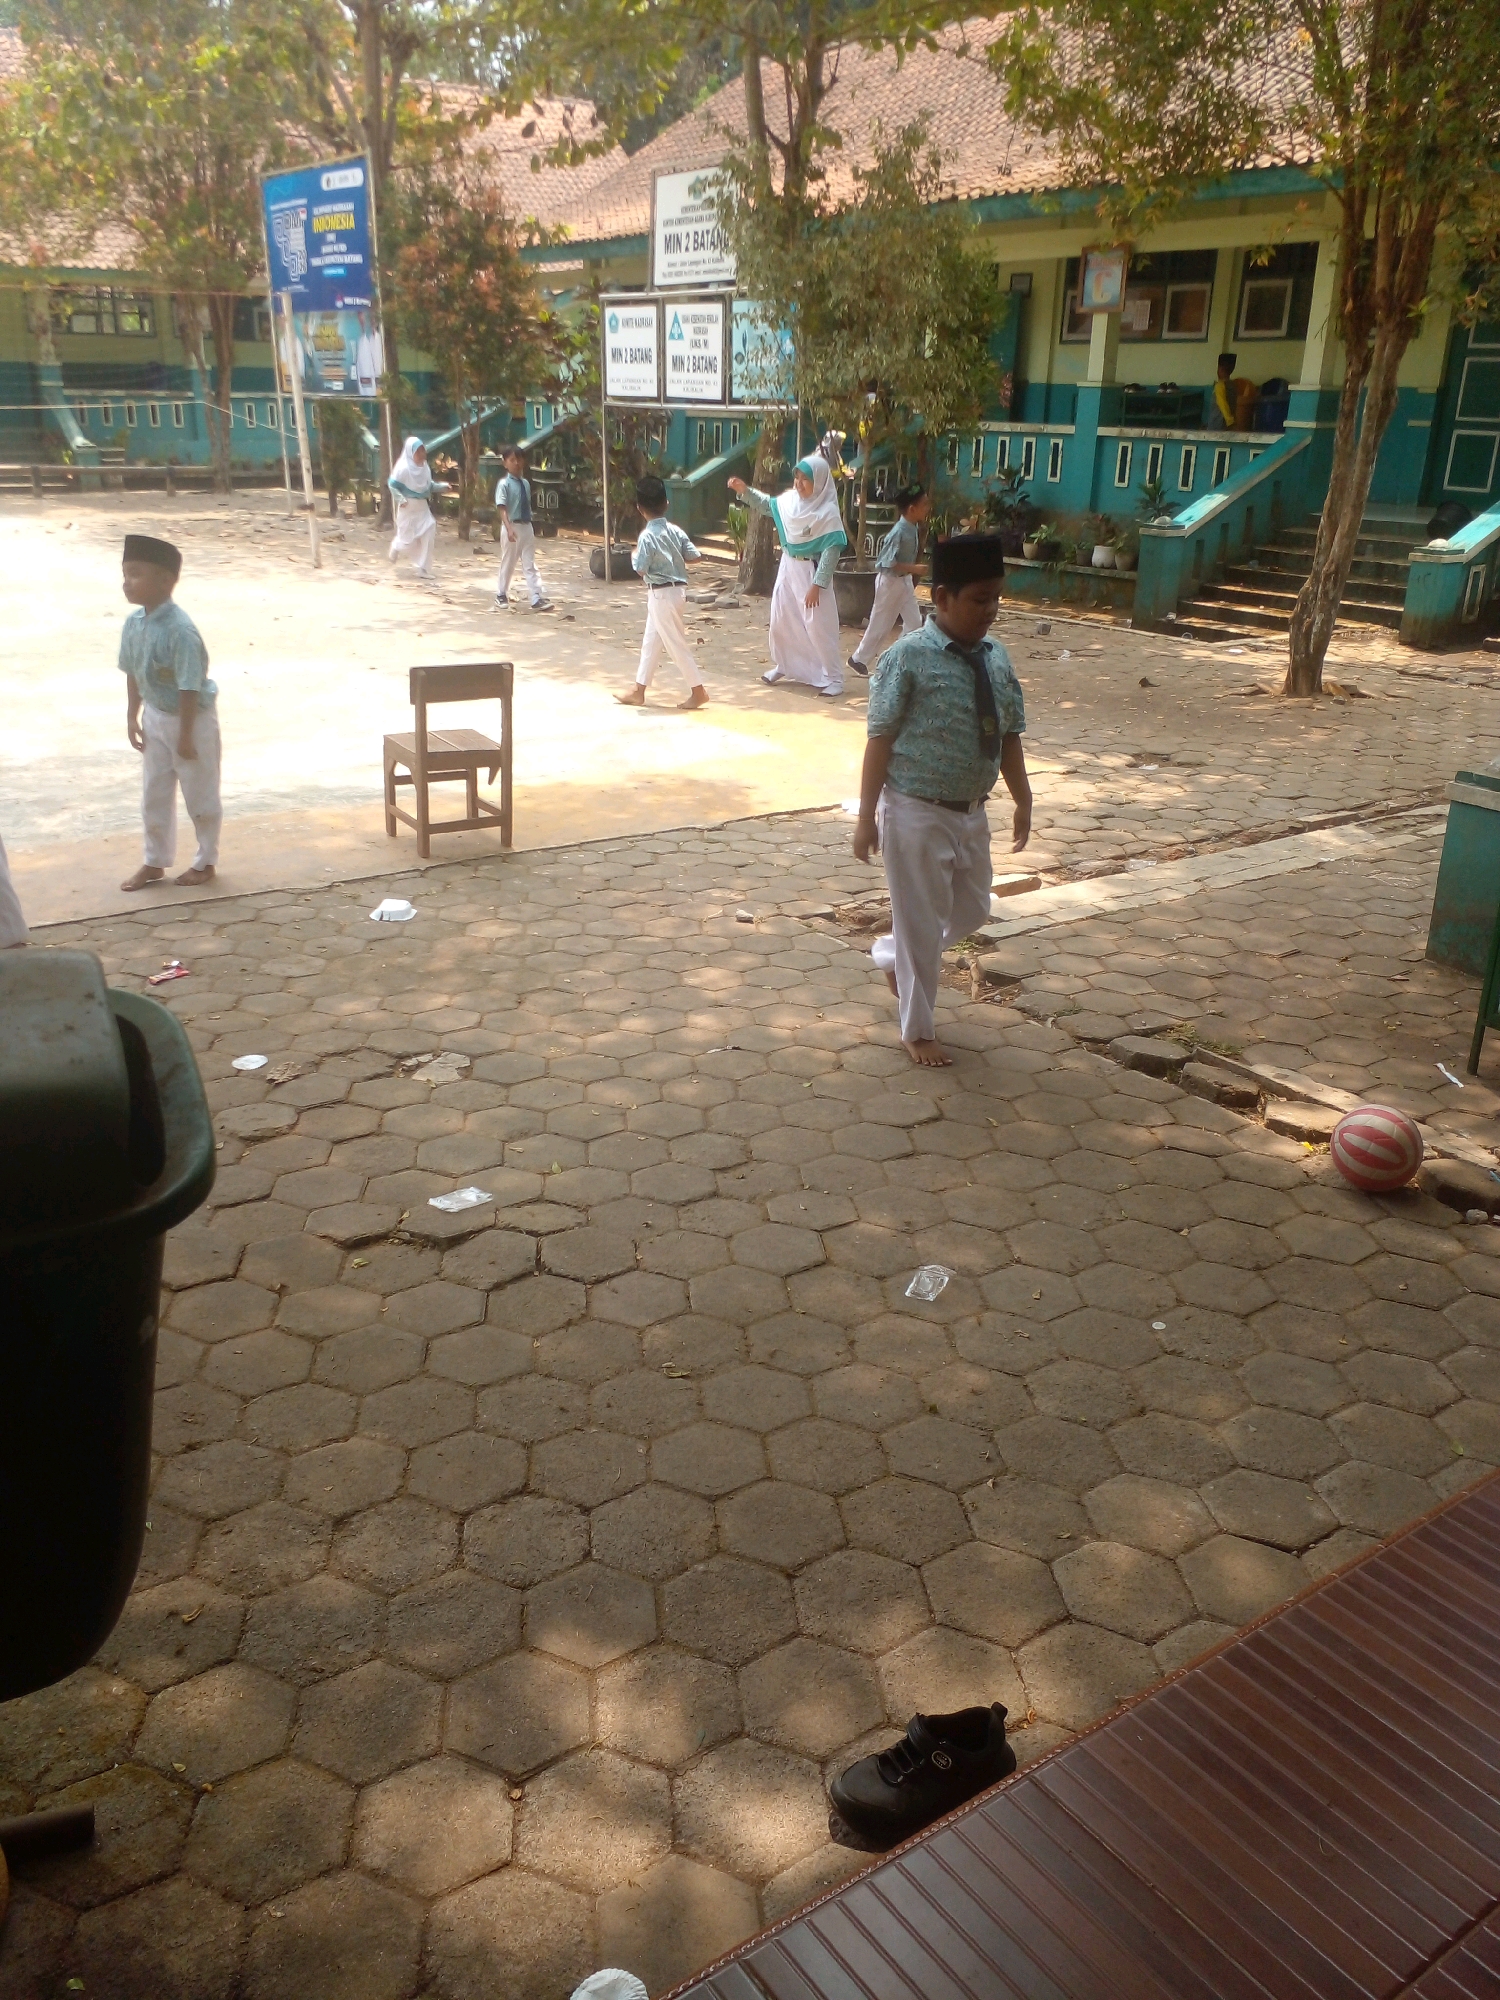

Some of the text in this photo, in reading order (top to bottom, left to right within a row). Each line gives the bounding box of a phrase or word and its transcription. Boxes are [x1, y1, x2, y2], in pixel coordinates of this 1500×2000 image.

[664, 227, 730, 255] MIN 2 BATANG
[611, 347, 653, 364] MIN 2 BATANG
[672, 355, 718, 374] MIN 2 BATANG
